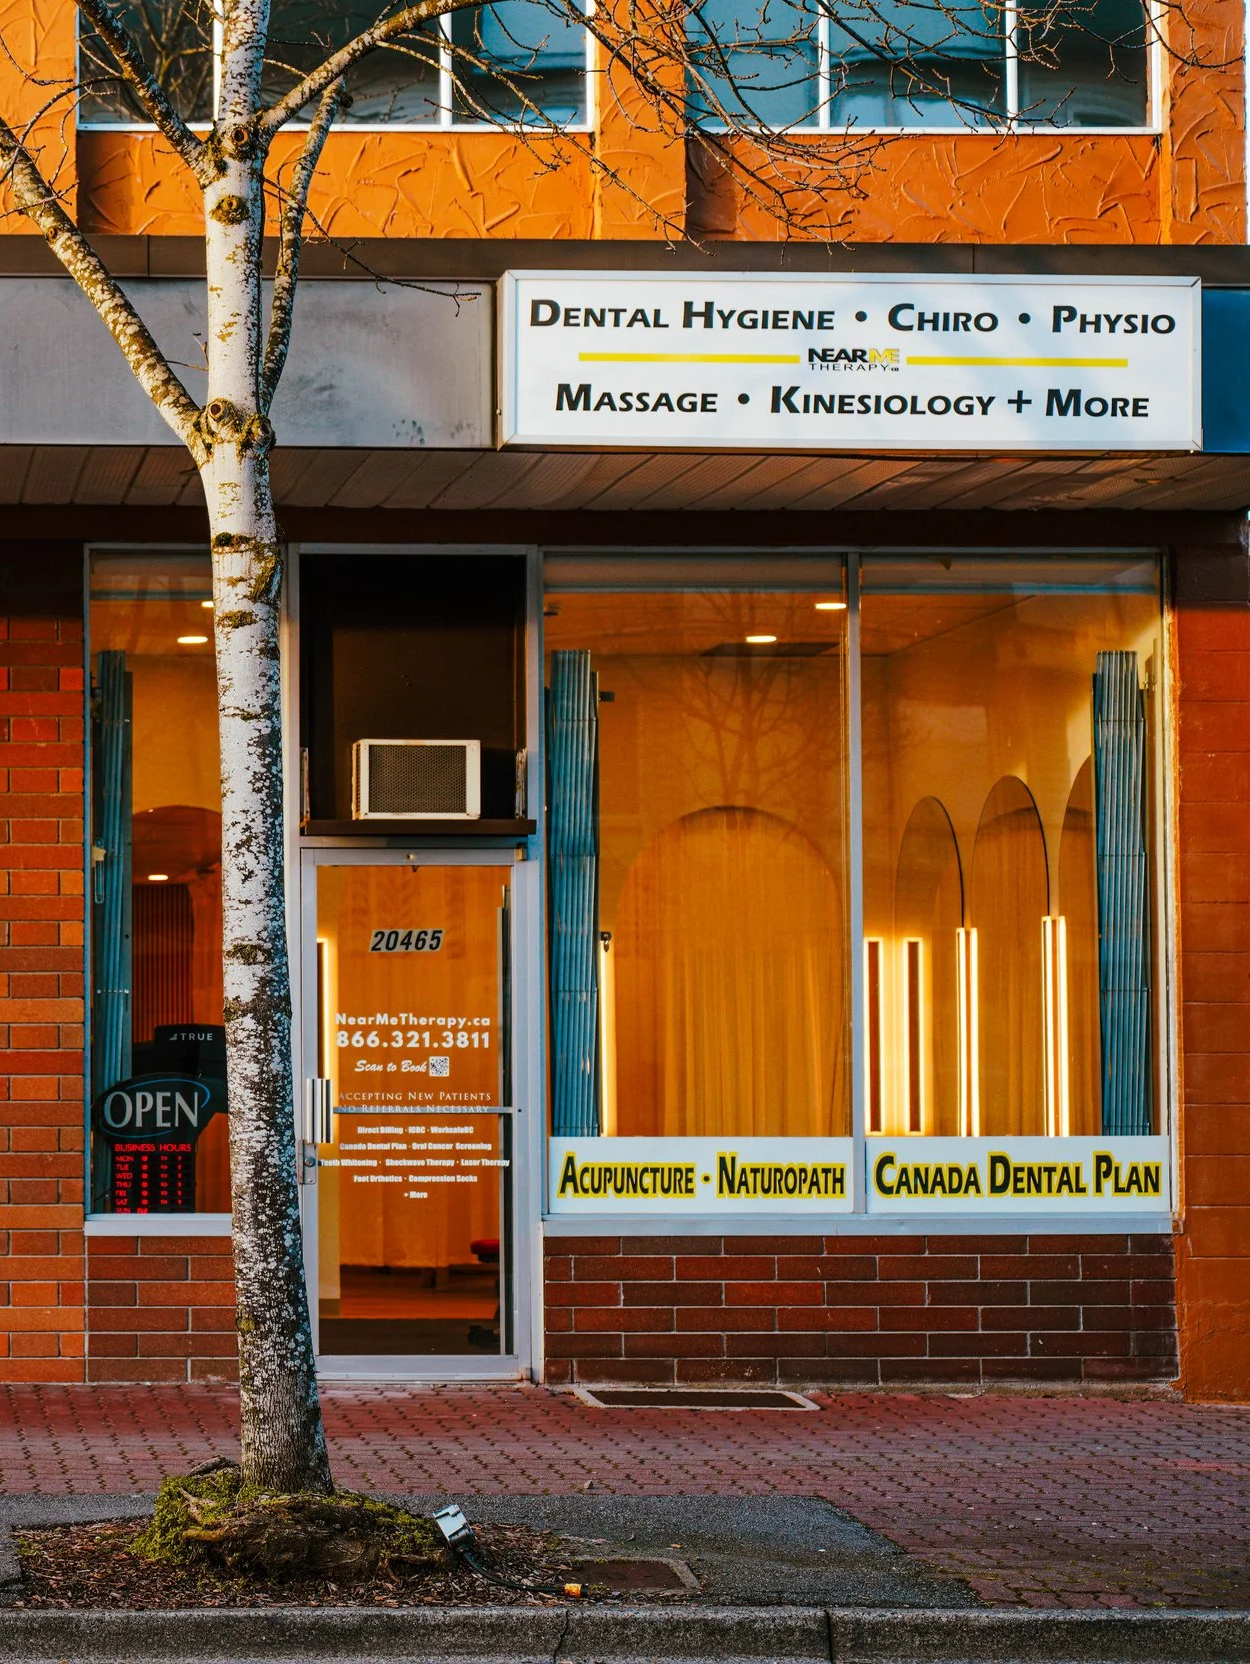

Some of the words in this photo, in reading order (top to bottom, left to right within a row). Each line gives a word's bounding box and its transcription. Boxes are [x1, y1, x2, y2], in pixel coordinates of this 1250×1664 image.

[530, 299, 669, 329] DENTAL
[683, 301, 835, 330] HYGIENE
[888, 303, 999, 332] CHIRO
[1052, 305, 1175, 334] PHYSIO
[808, 363, 889, 371] THERAPY
[555, 383, 718, 412] MASSAGE
[770, 386, 995, 416] KINESIOLOGY
[1046, 389, 1149, 417] MORE
[371, 930, 443, 951] 20465
[335, 1013, 490, 1028] NearMeTherapy.ca
[180, 1033, 213, 1041] TRUE
[336, 1031, 490, 1048] 866.321.3811
[354, 1060, 384, 1073] Scan
[387, 1062, 397, 1072] to
[401, 1060, 427, 1073] Book
[408, 1091, 434, 1100] NEW
[439, 1091, 491, 1100] PATIENTS
[104, 1091, 198, 1128] OPEN
[115, 1144, 156, 1152] BUSINESS
[159, 1144, 192, 1152] HOURS
[558, 1154, 695, 1196] ACUPUNCTURE
[717, 1154, 845, 1196] NATUROPATH
[874, 1154, 983, 1196] CANADA
[988, 1153, 1088, 1195] DENTAL
[1094, 1152, 1161, 1195] PLAN
